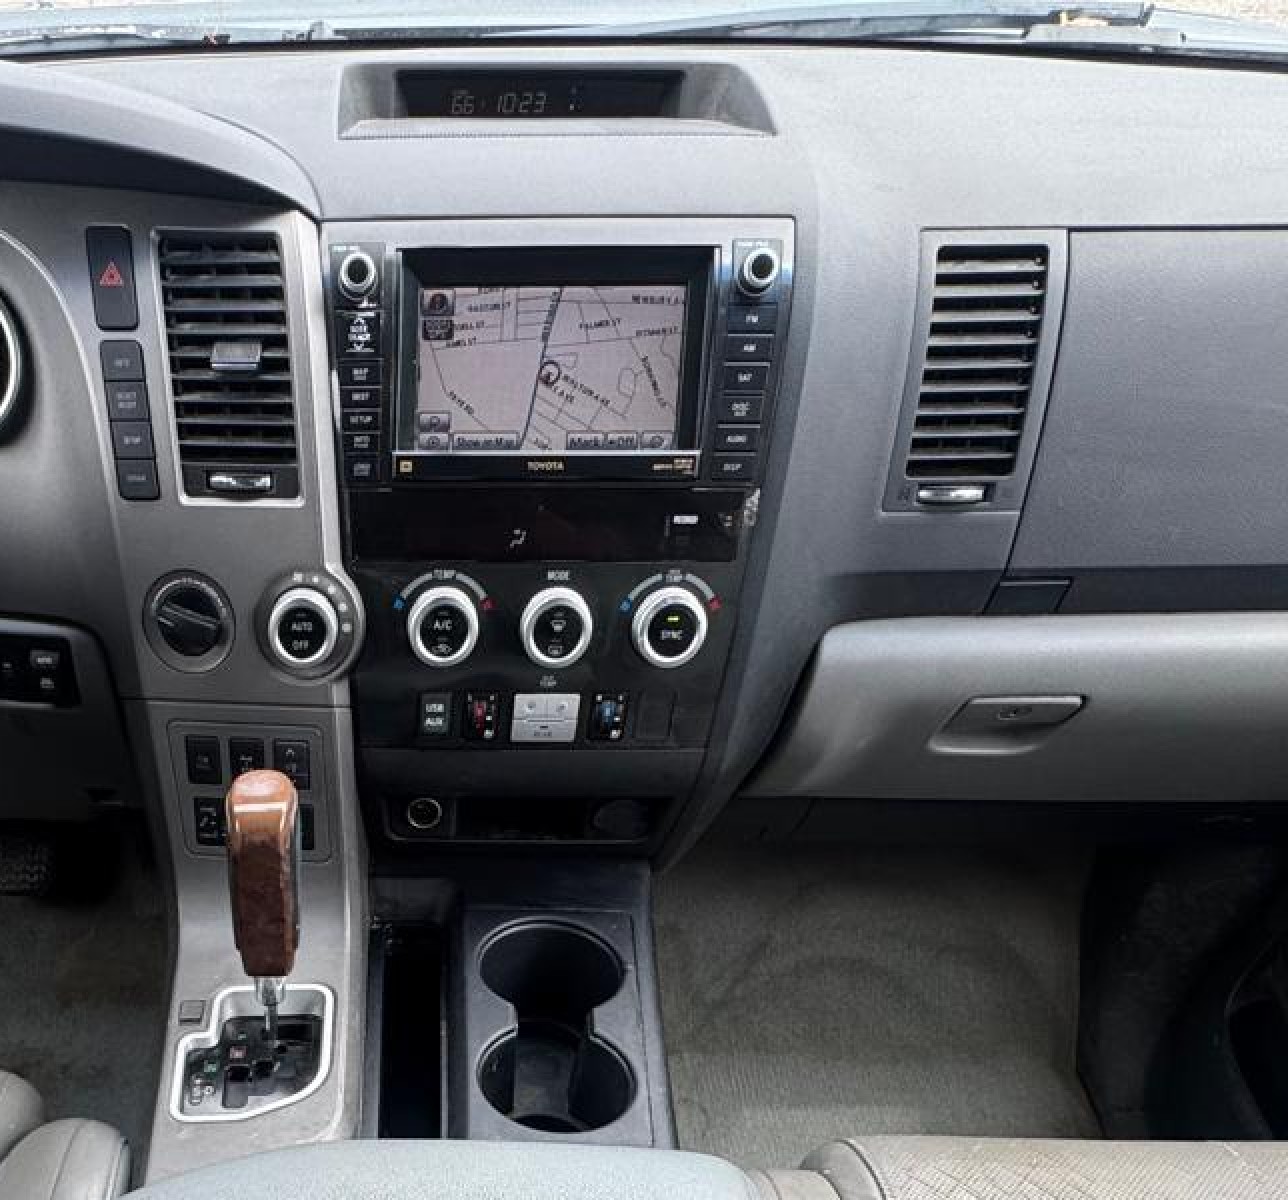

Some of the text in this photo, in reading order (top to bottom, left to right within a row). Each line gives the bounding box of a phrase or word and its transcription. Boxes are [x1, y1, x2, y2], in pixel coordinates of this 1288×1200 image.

[737, 373, 753, 382] SAT
[527, 461, 565, 470] TOYOTA
[433, 570, 457, 580] TEMP
[547, 570, 570, 580] MODE
[291, 621, 312, 631] AUTO
[433, 620, 453, 631] A/C
[425, 703, 445, 713] USB
[424, 718, 444, 727] AUX
